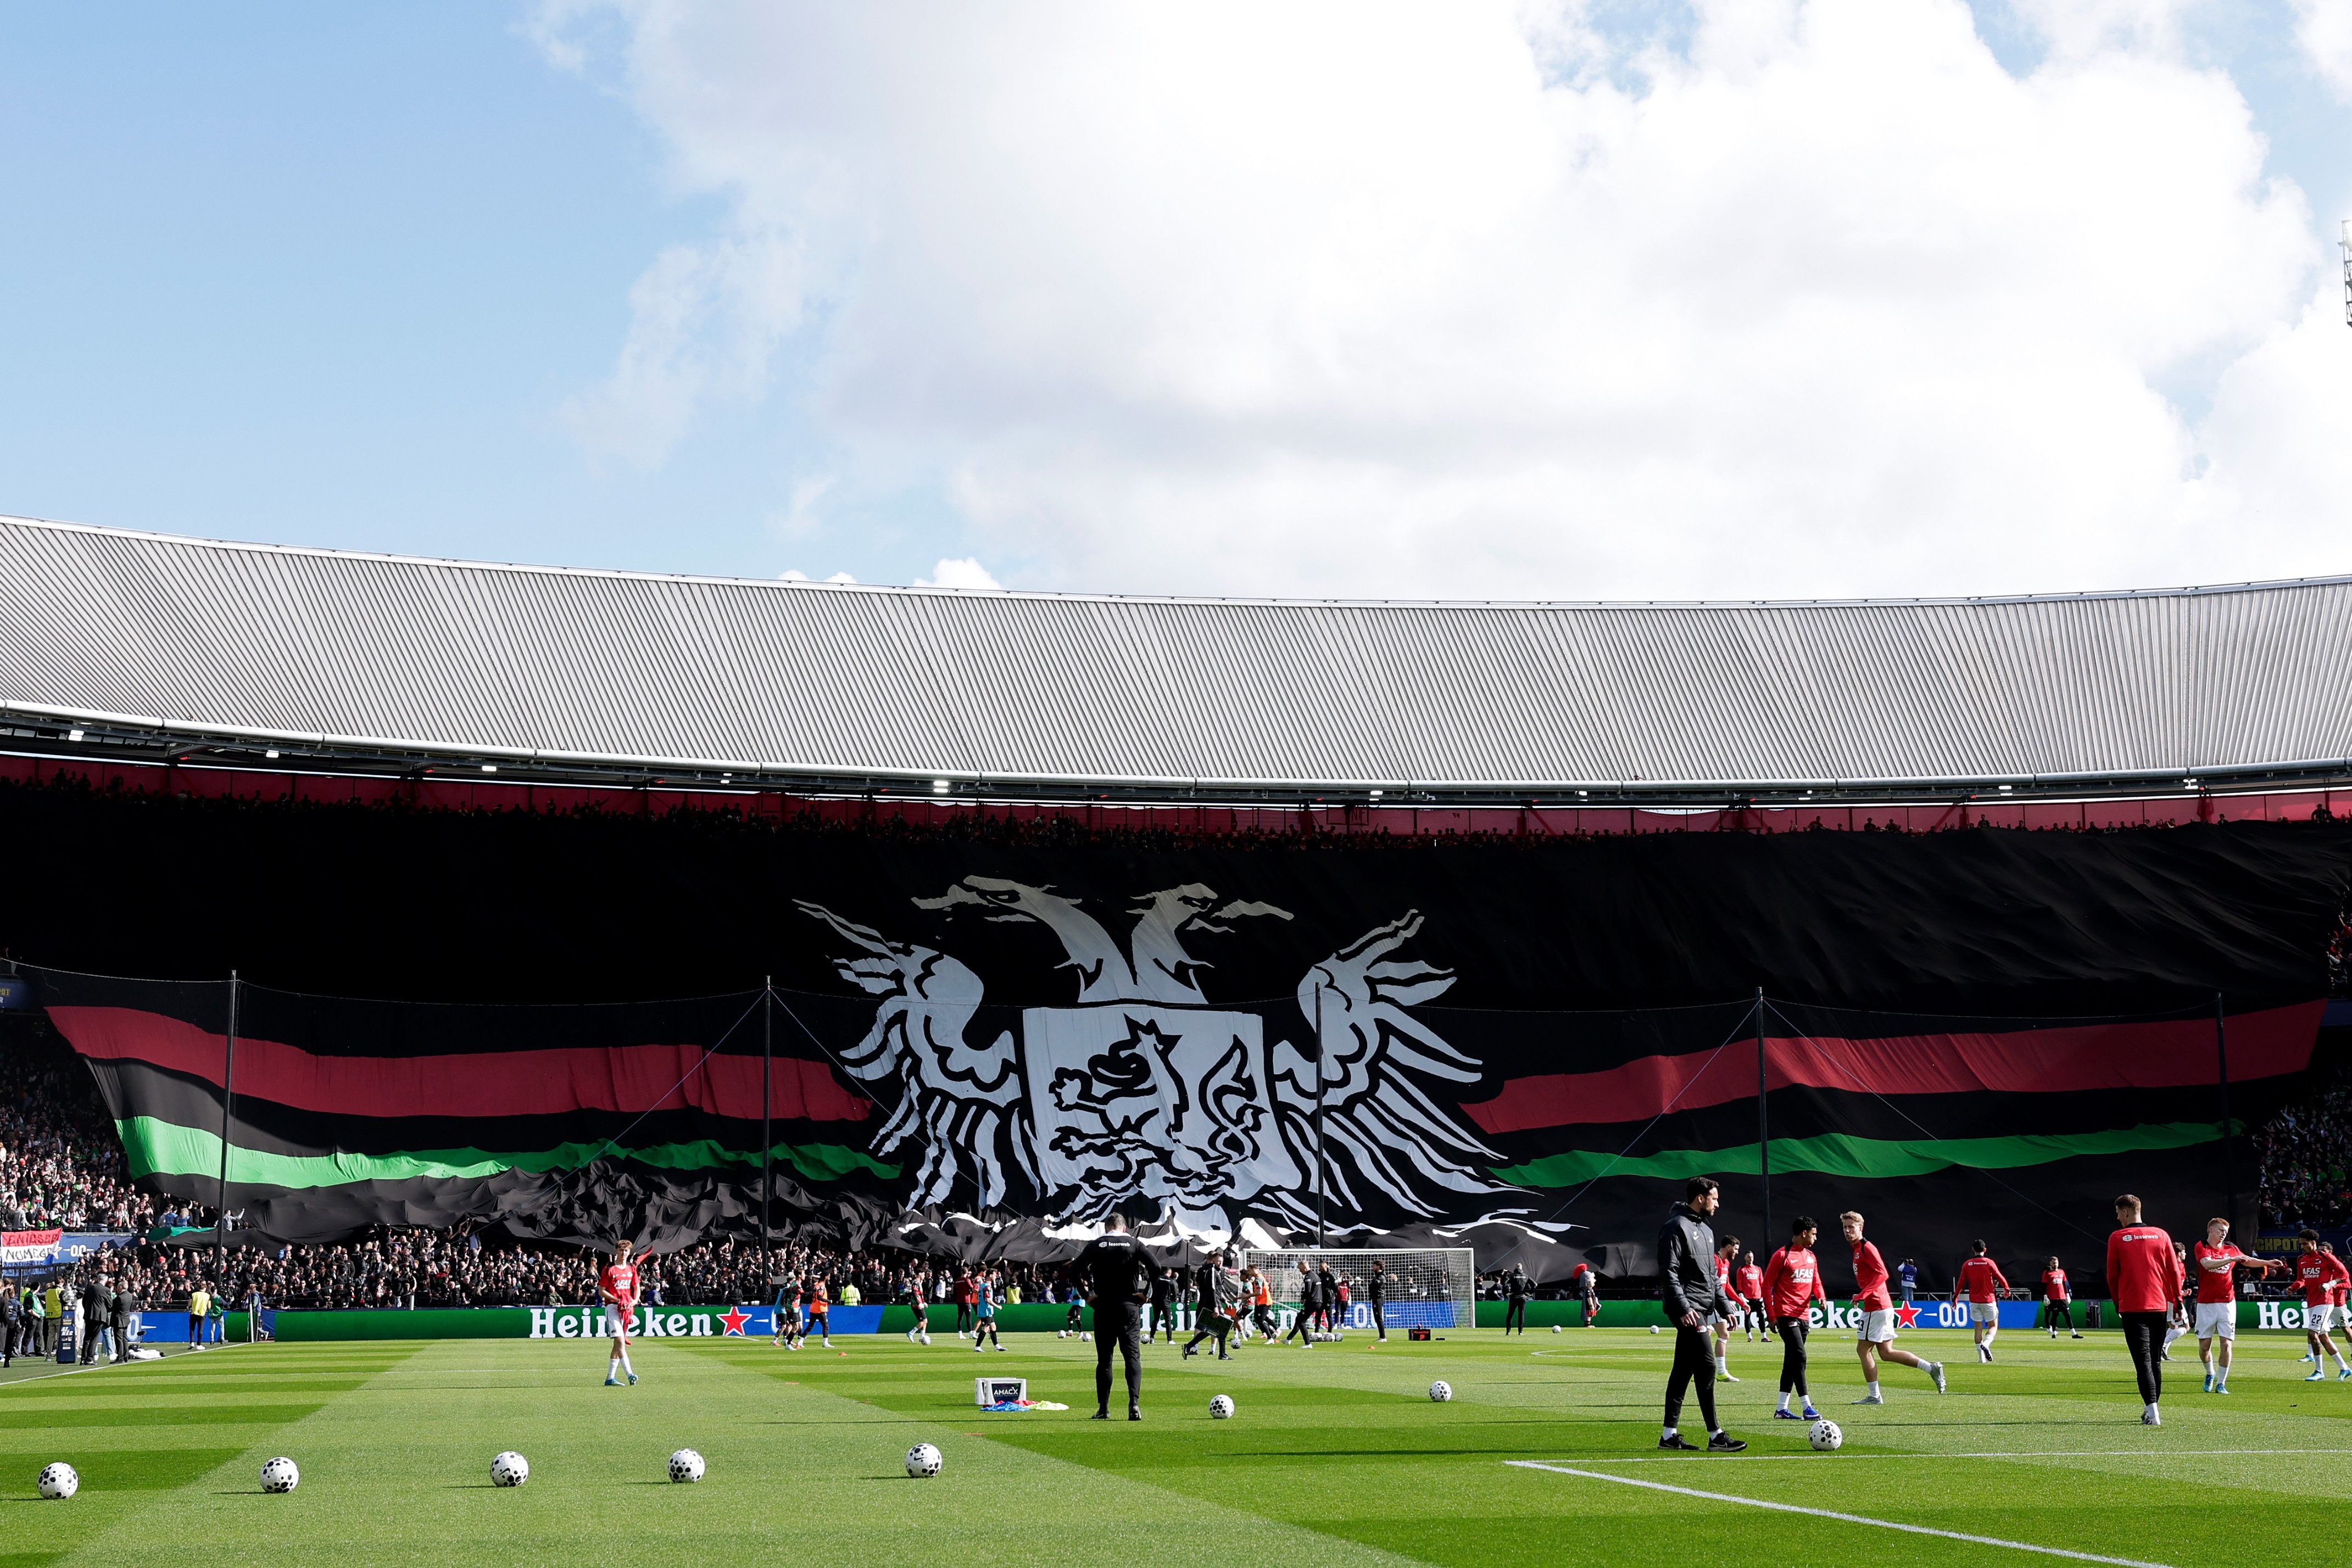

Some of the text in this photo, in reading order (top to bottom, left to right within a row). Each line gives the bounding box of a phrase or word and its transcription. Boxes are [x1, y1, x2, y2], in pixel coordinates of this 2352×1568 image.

[1791, 1268, 1814, 1278] AFAS
[1938, 1302, 1968, 1327] 0.0
[993, 1386, 1019, 1396] AMACX
